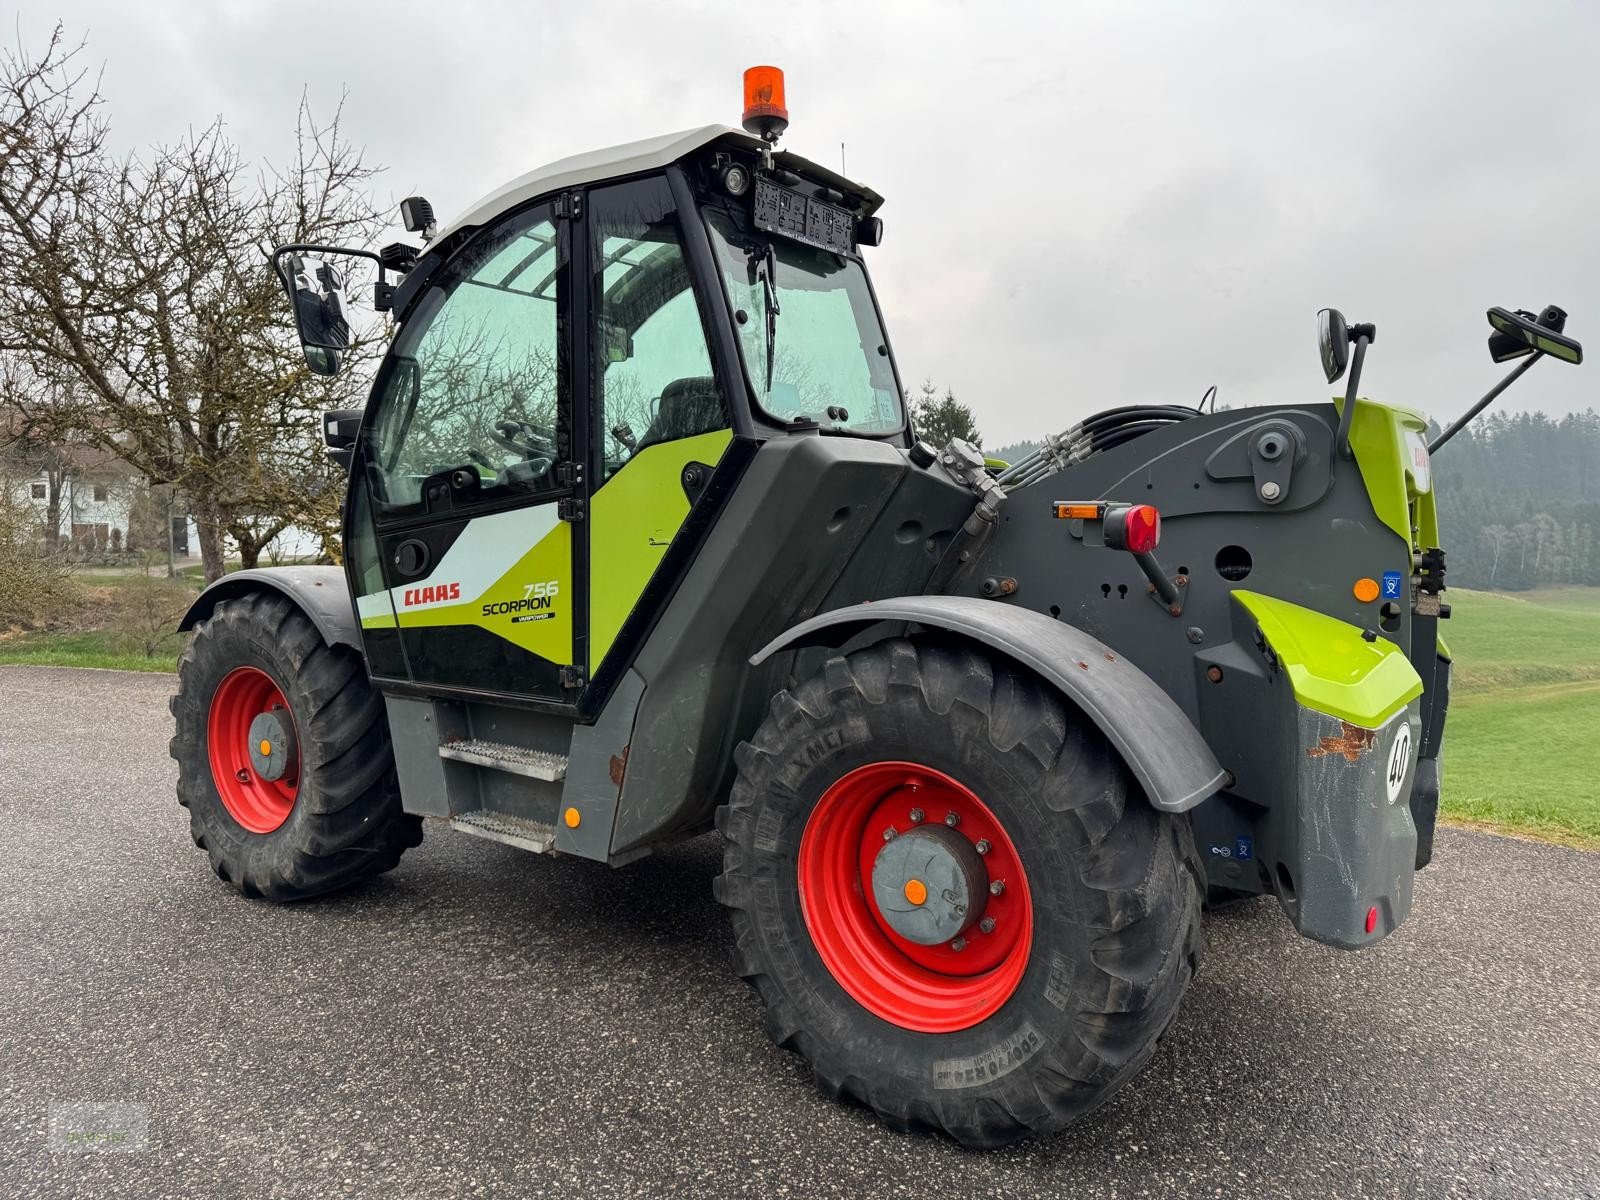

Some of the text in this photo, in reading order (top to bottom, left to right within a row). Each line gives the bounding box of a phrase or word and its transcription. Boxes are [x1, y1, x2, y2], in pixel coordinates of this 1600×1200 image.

[404, 582, 460, 606] CLAAS
[523, 581, 559, 598] 756
[482, 596, 551, 616] SCORPION
[1389, 734, 1408, 787] 40
